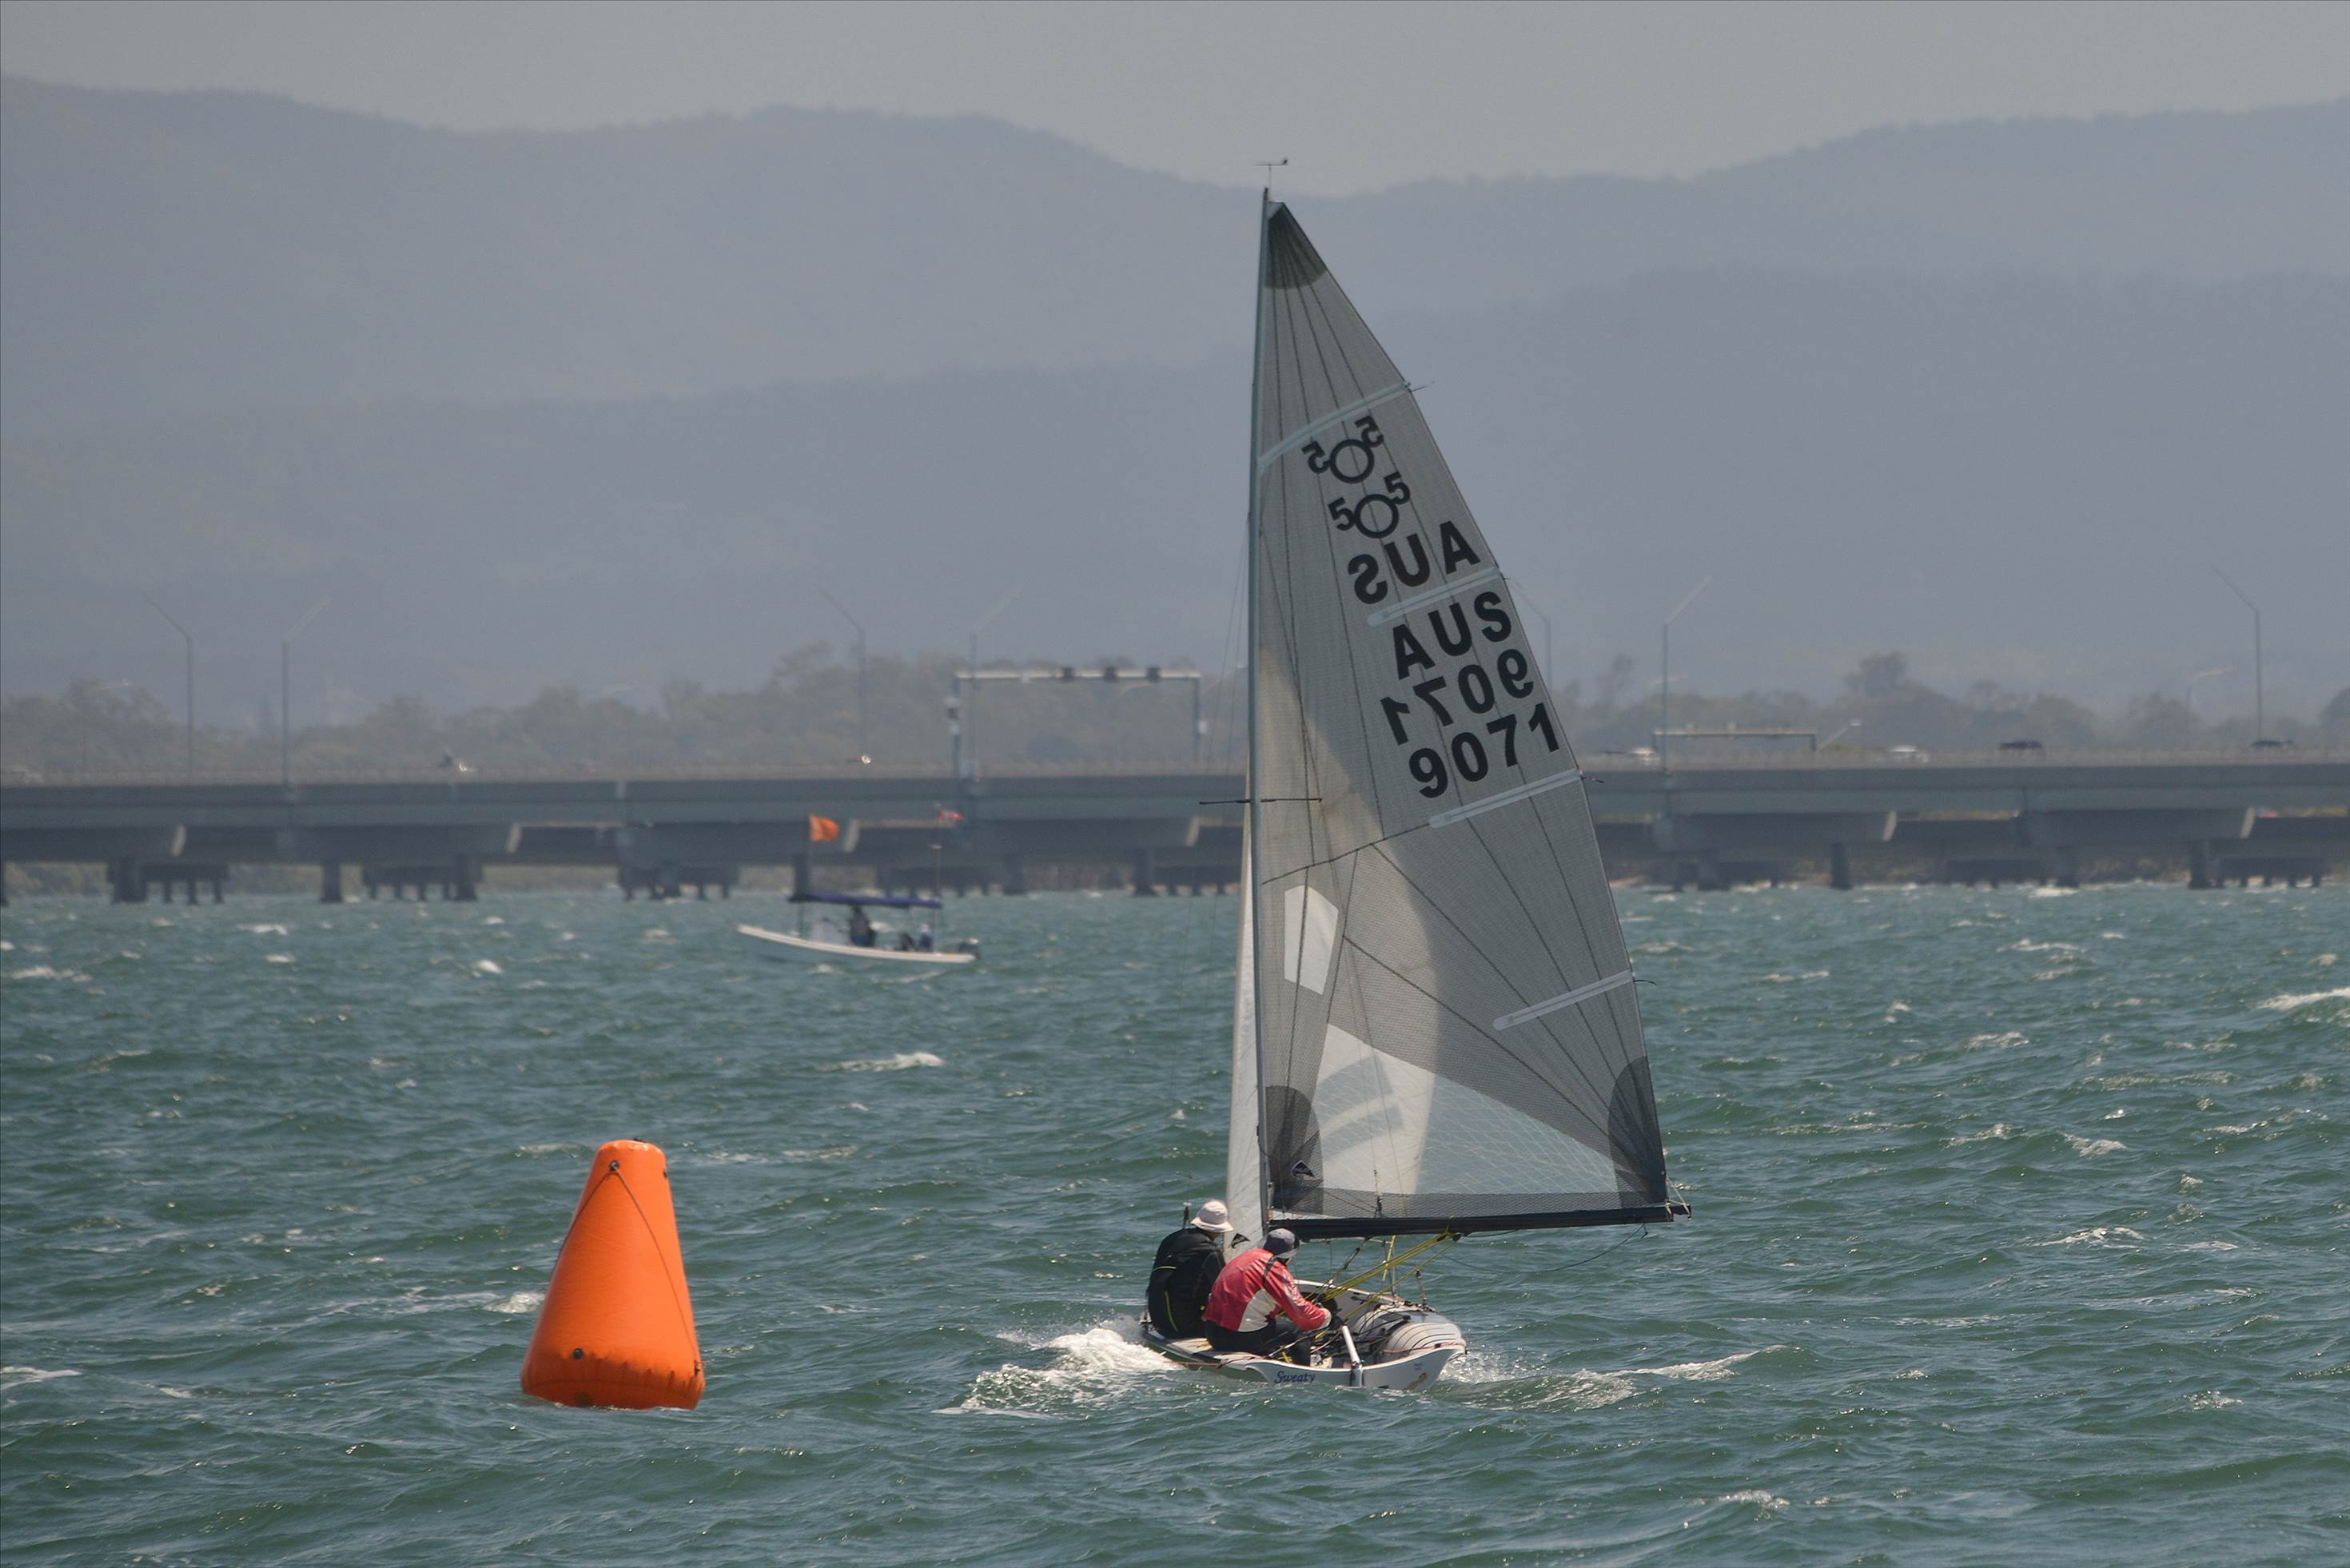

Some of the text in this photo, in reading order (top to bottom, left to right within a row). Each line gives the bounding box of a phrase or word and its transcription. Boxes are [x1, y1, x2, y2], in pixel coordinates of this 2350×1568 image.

[1328, 472, 1411, 539] 505
[1392, 591, 1512, 680] AUS
[1408, 702, 1559, 798] 9071
